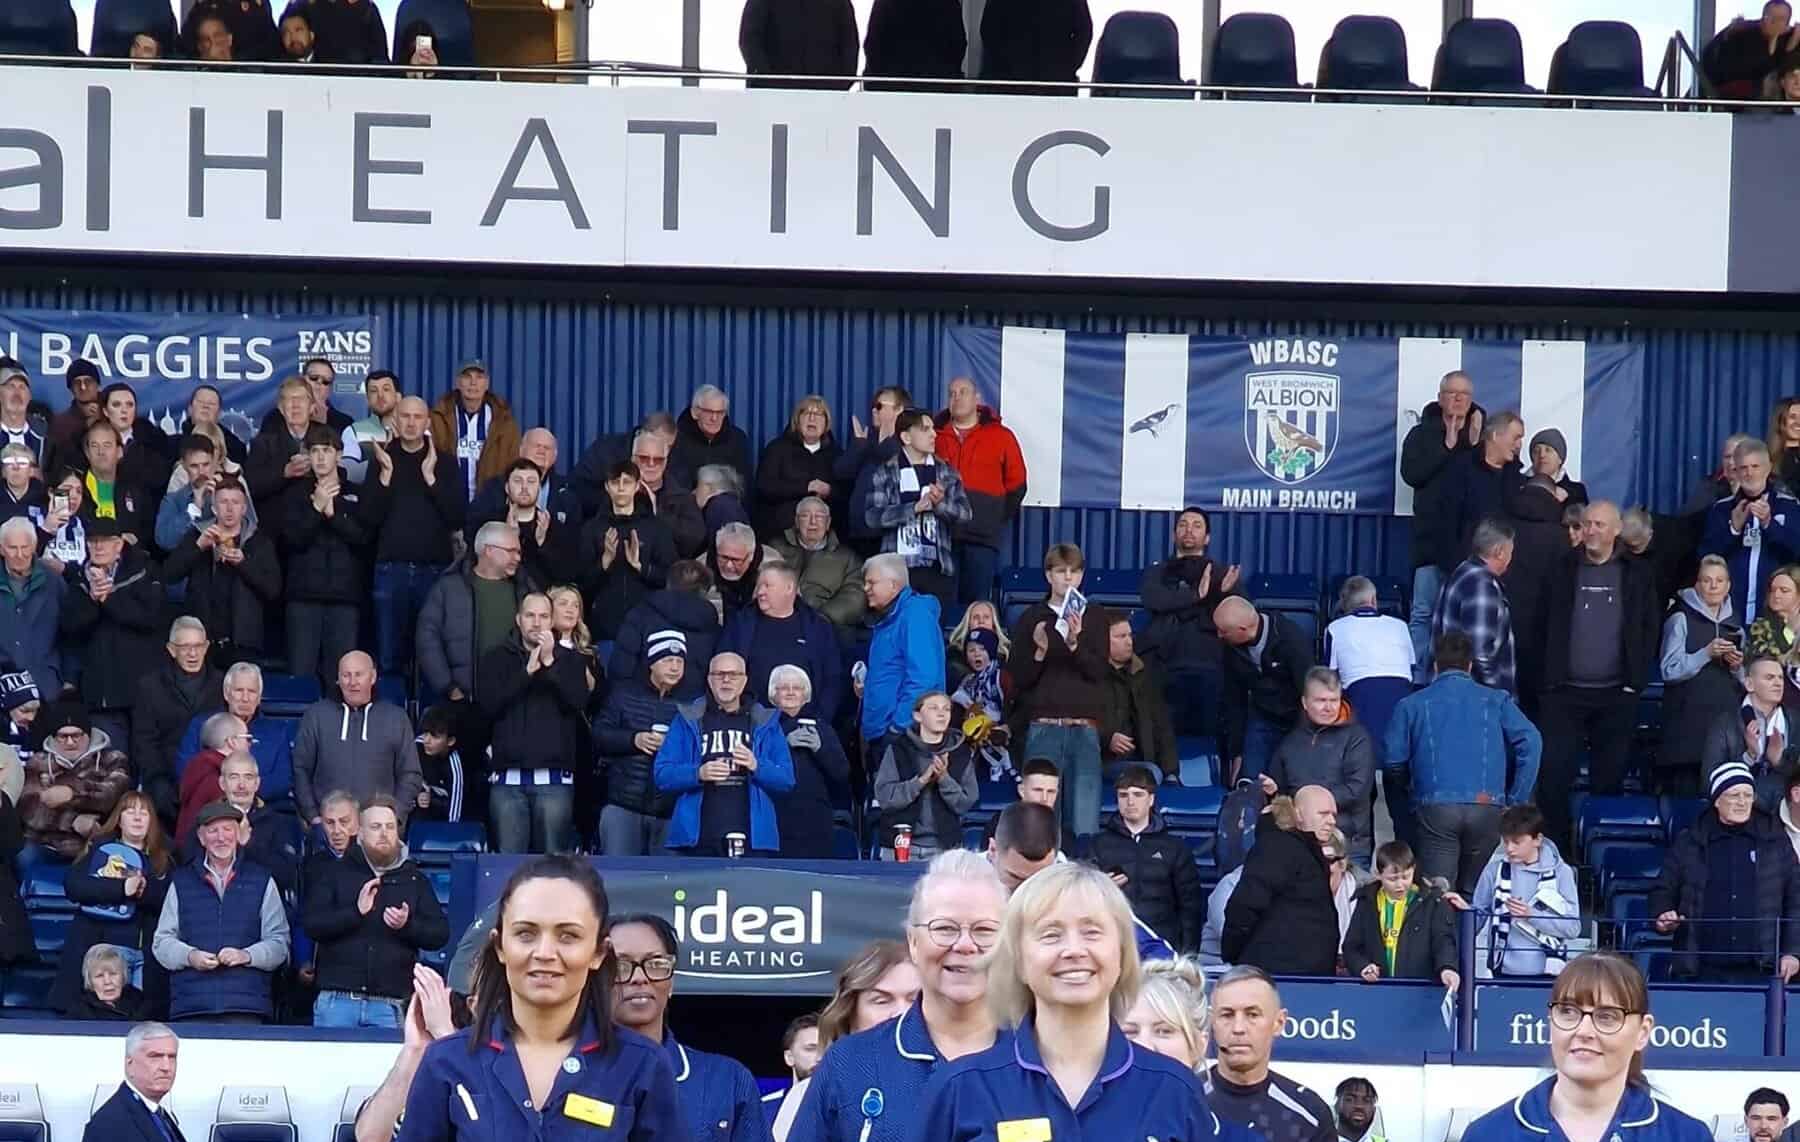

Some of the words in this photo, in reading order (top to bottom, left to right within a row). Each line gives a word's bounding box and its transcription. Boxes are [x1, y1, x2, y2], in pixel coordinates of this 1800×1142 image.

[187, 106, 1112, 242] HEATING
[298, 331, 371, 353] FANS
[1249, 339, 1339, 367] WBASC
[41, 331, 273, 381] BAGGIES
[1251, 379, 1277, 389] WEST
[1280, 379, 1334, 390] BROMWICH
[1252, 389, 1333, 407] ALBION
[1222, 487, 1272, 508] MAIN
[1278, 489, 1357, 510] BRANCH
[673, 889, 823, 945] ideal
[690, 950, 804, 967] HEATING
[239, 1091, 269, 1105] ideal
